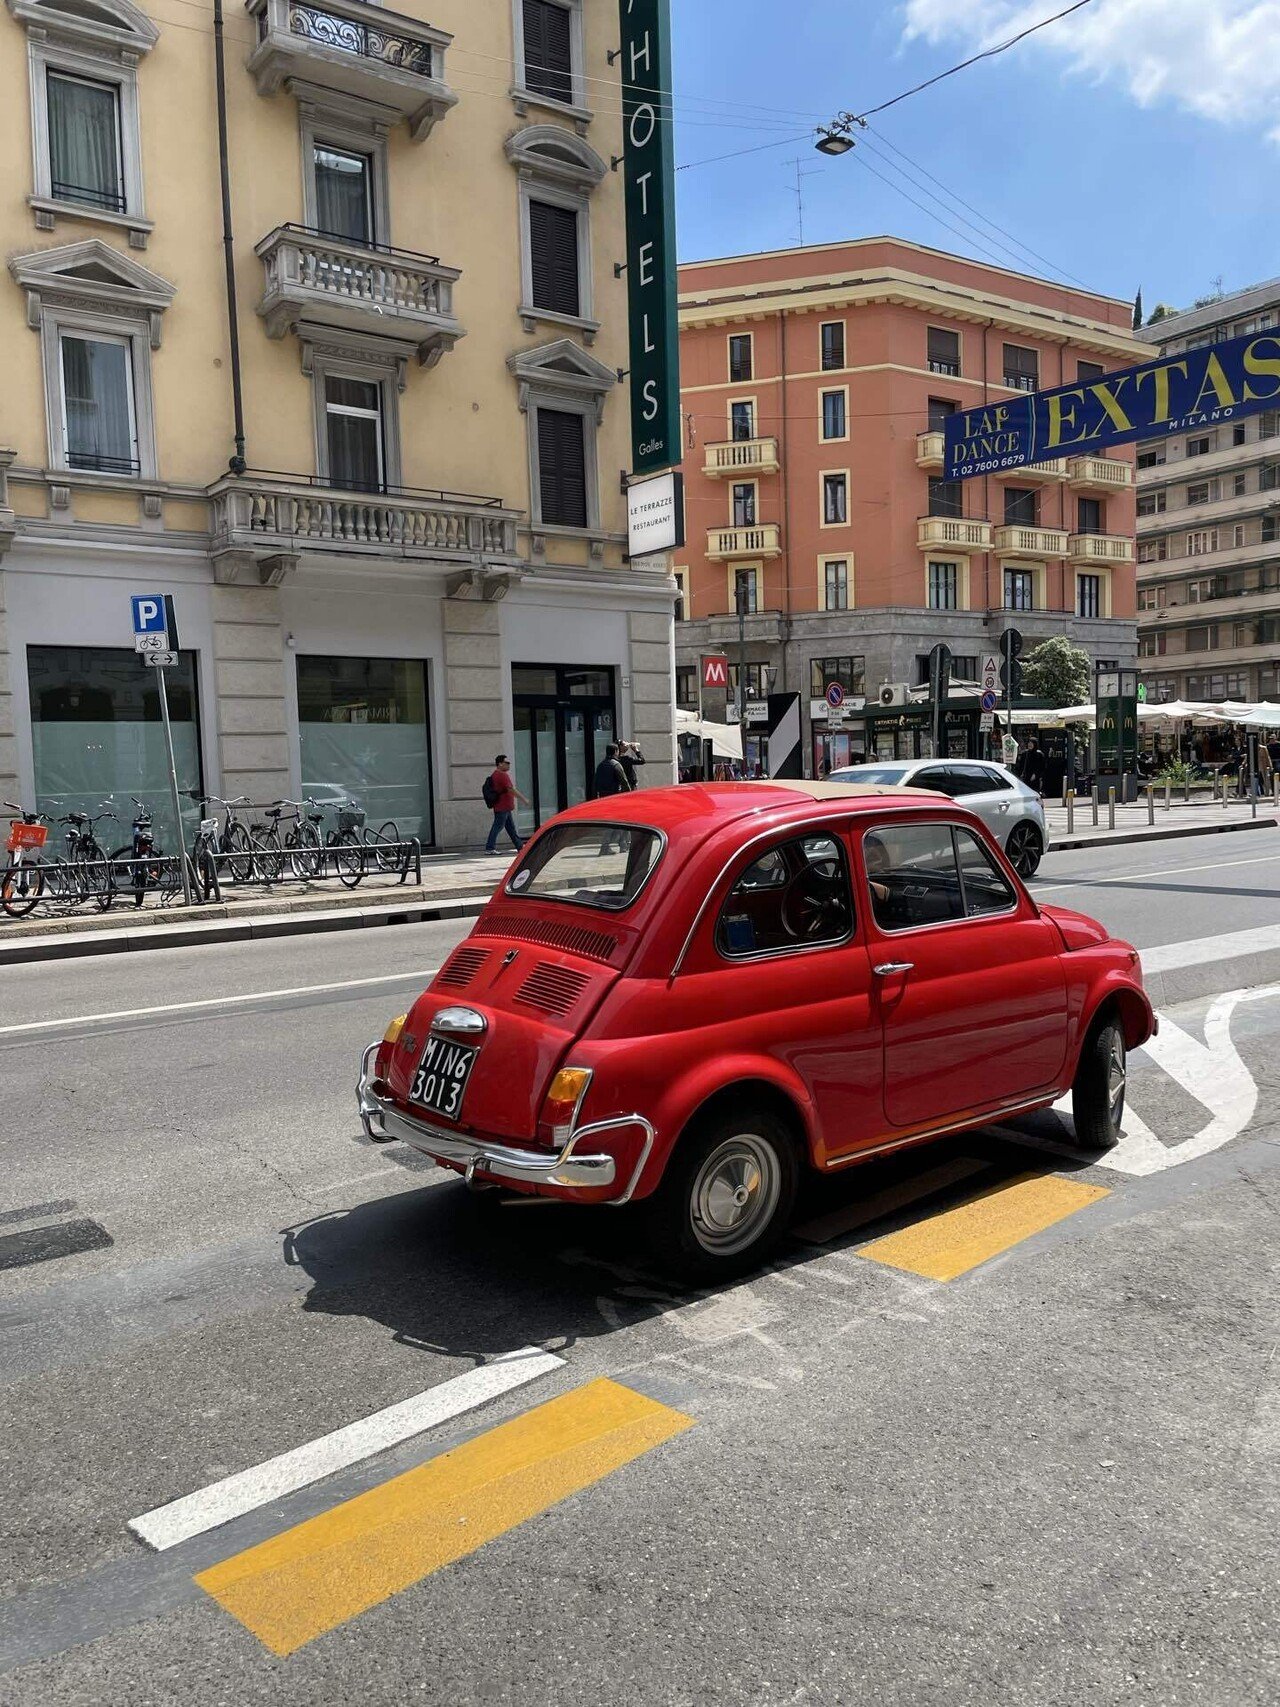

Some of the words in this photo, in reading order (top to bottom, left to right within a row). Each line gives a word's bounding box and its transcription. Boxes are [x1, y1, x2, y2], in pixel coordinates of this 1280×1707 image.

[629, 30, 660, 421] HOTELS
[1169, 407, 1233, 430] MILANO
[638, 438, 664, 456] Galles
[953, 431, 1020, 464] DANCE
[952, 468, 959, 477] T.
[961, 465, 973, 475] 02
[975, 459, 999, 472] 7600
[1001, 454, 1025, 466] 6679
[630, 505, 638, 516] LE
[640, 496, 673, 513] TERRAZZE
[633, 514, 671, 531] RESTAURANT
[138, 600, 158, 629] P
[706, 663, 725, 682] M
[410, 1069, 462, 1113] 3013
